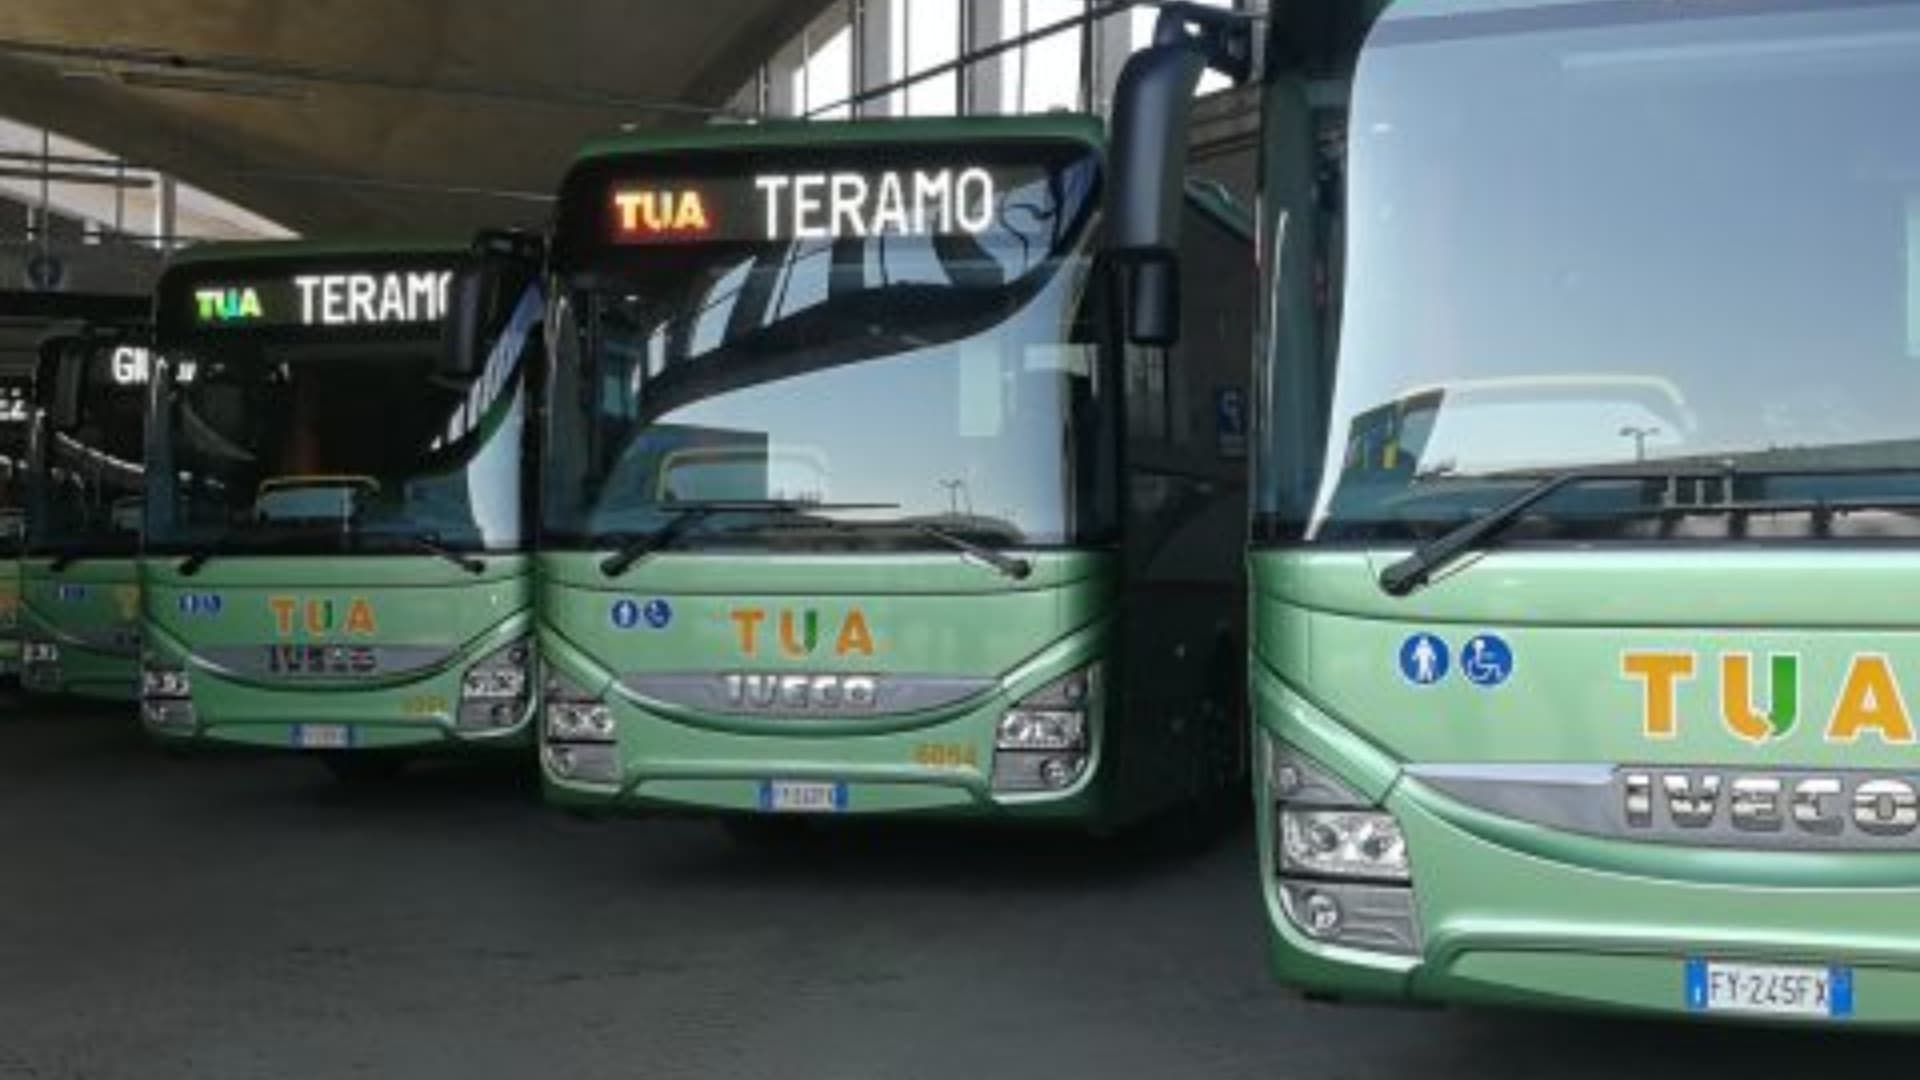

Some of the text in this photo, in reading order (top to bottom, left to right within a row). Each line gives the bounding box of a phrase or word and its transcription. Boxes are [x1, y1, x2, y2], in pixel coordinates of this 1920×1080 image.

[614, 190, 708, 231] TUA
[755, 167, 995, 240] TERAMO
[195, 287, 261, 320] TUA
[270, 597, 376, 637] TUA
[730, 608, 874, 660] TUA
[724, 674, 877, 708] IVECO
[1621, 651, 1916, 744] TUA
[1624, 774, 1920, 837] IVECO
